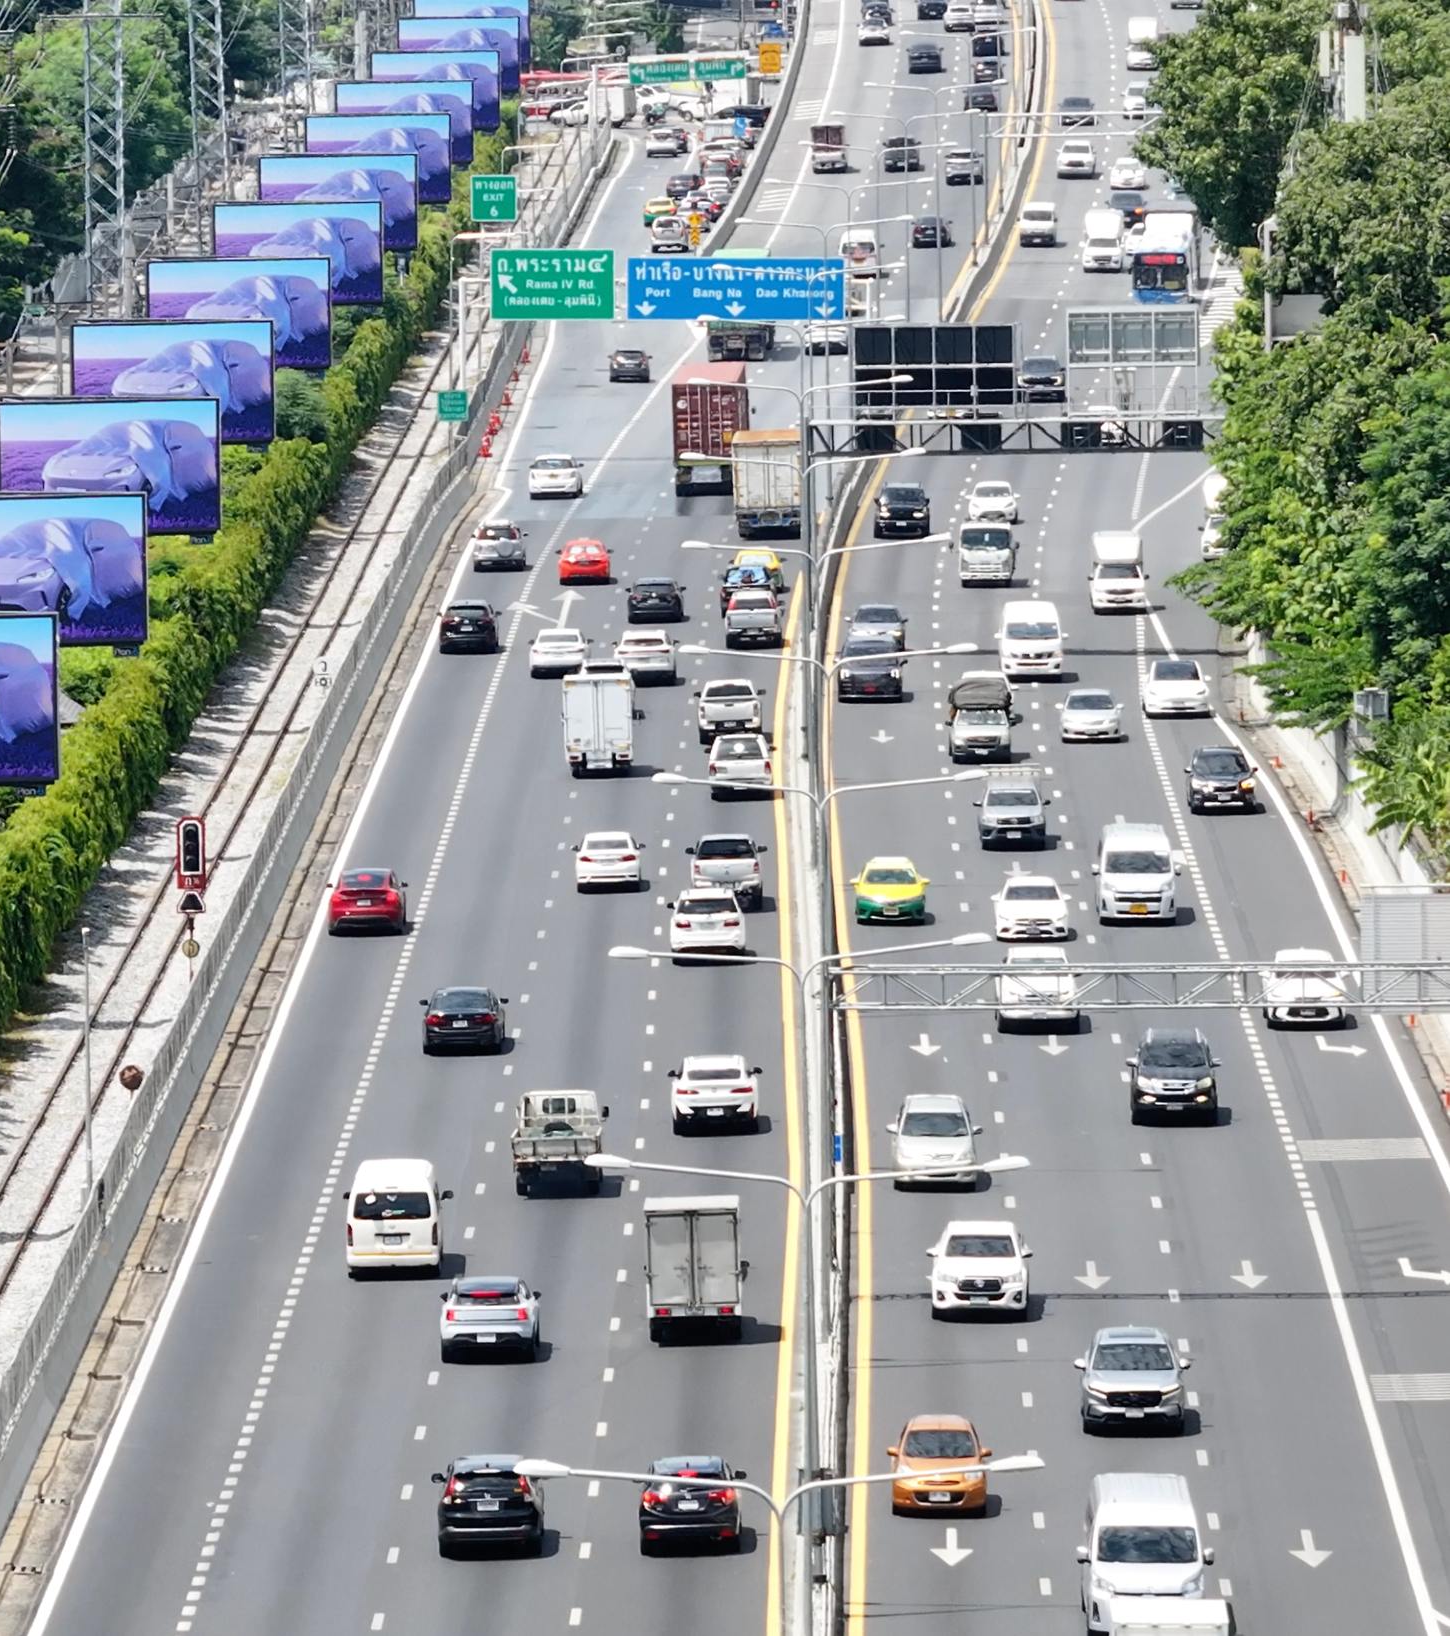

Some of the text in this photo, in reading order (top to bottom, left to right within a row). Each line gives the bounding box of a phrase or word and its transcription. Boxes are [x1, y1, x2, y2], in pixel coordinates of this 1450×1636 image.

[475, 181, 513, 190] ทางออก
[483, 193, 504, 201] EXIT
[490, 205, 498, 217] 6
[526, 279, 558, 289] Rama
[561, 279, 574, 289] IV
[645, 287, 671, 298] Port
[693, 287, 723, 301] Bang
[726, 288, 742, 298] Na
[755, 288, 779, 298] Dao
